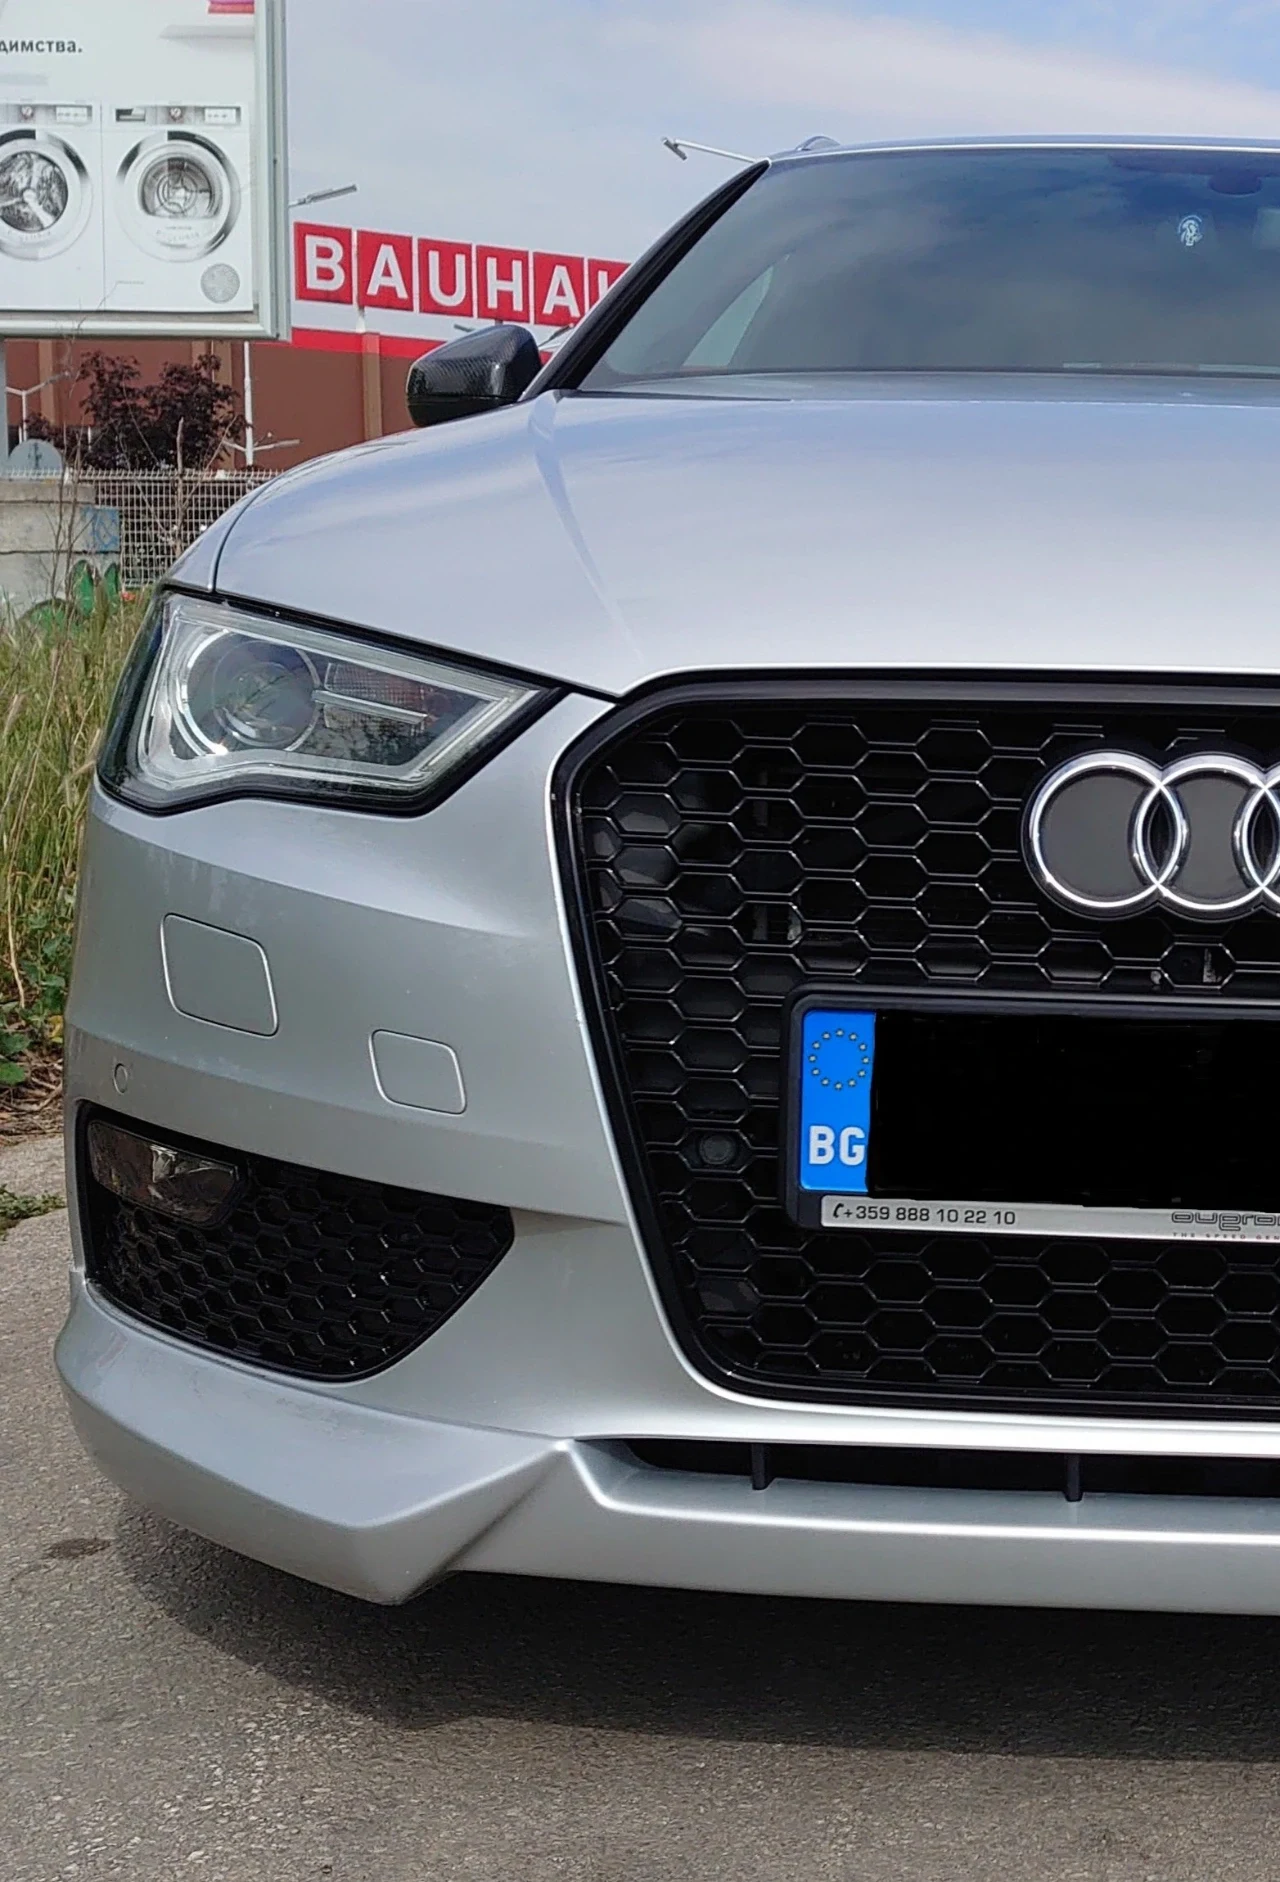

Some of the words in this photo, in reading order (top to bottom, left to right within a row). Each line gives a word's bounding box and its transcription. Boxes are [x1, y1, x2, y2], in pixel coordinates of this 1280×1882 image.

[809, 1125, 865, 1166] BG
[843, 1205, 890, 1220] +359
[896, 1207, 930, 1222] 888
[936, 1208, 959, 1223] 10
[963, 1210, 987, 1224] 22
[993, 1211, 1016, 1225] 10
